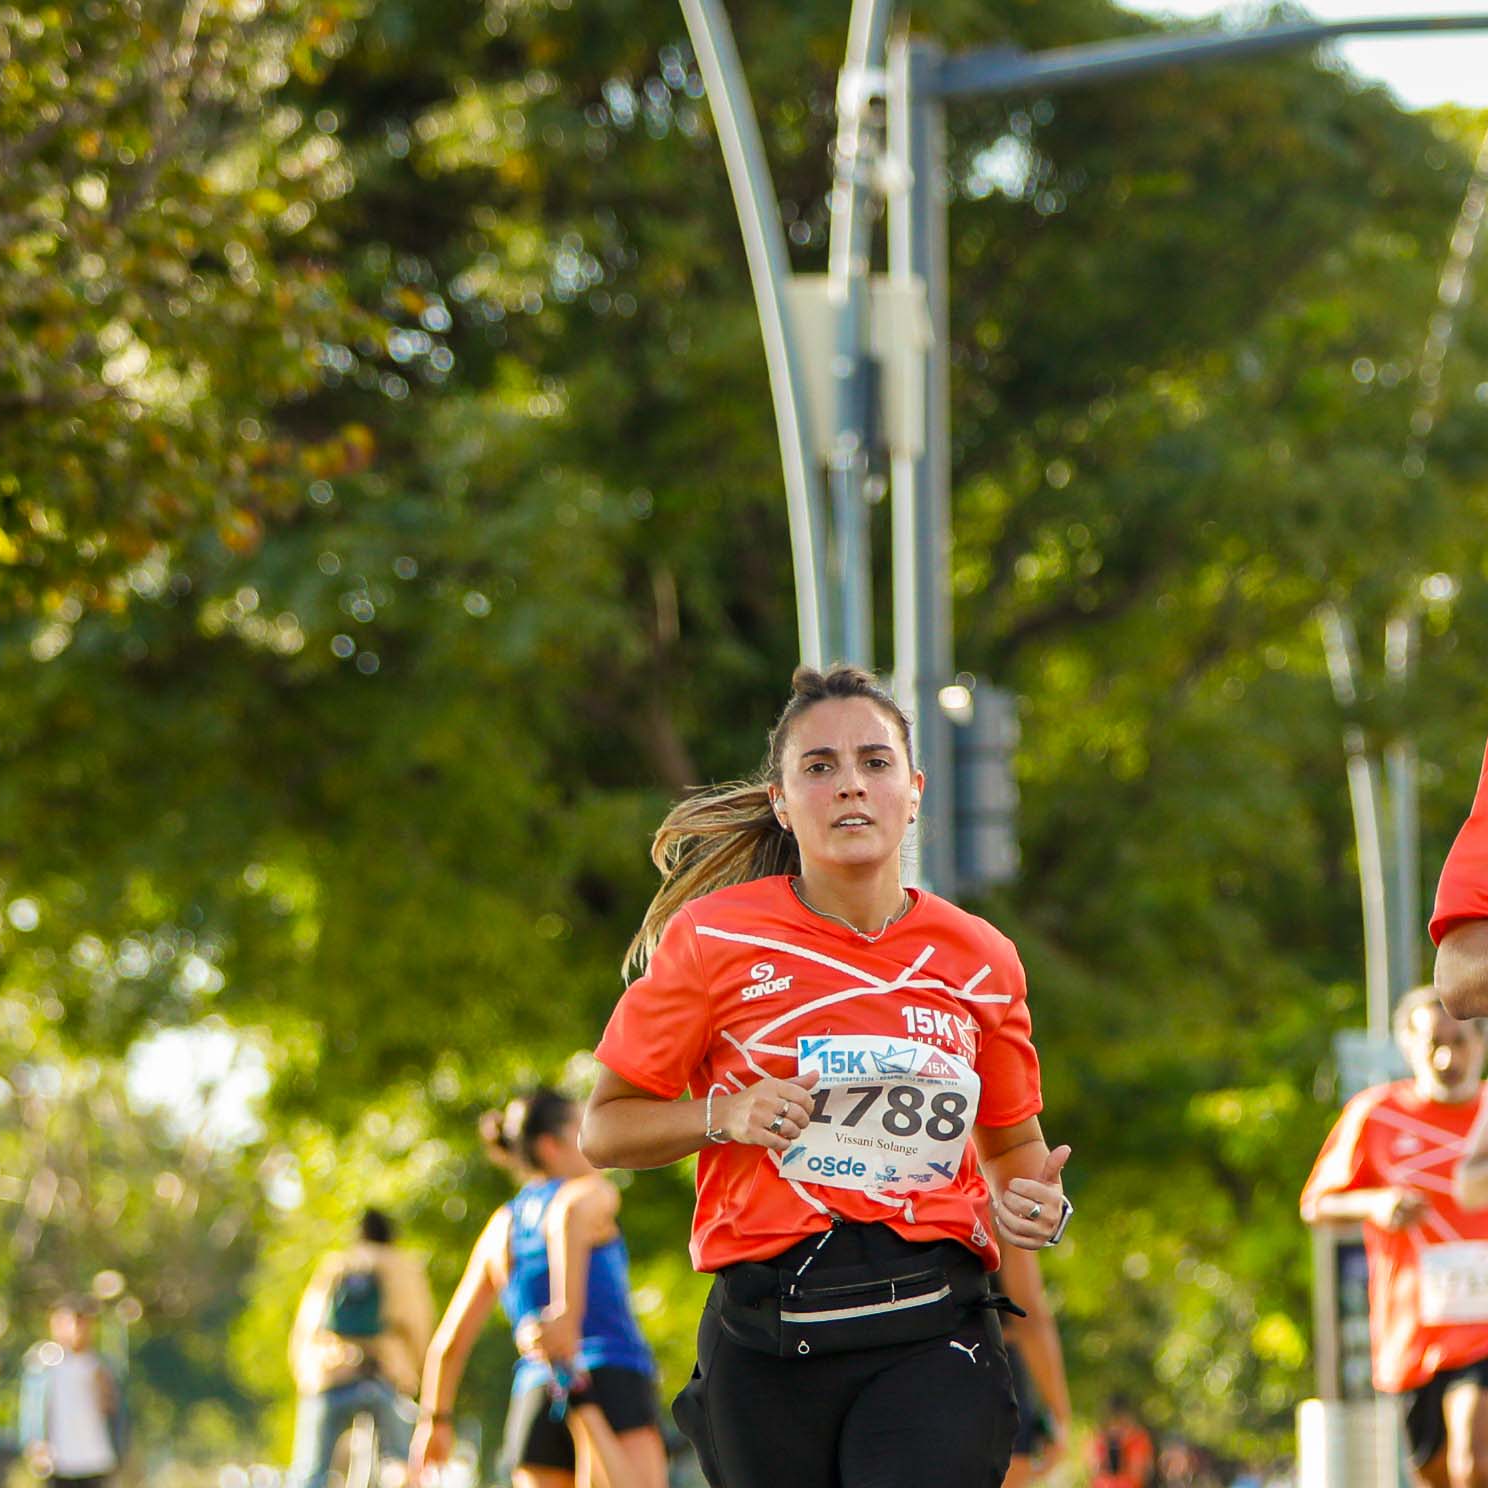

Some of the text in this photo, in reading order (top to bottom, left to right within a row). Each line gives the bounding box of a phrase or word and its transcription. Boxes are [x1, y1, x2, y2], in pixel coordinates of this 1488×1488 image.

[902, 1006, 954, 1041] 15K
[818, 1051, 867, 1075] 15K
[926, 1062, 950, 1075] 15K
[810, 1085, 968, 1142] 1788
[834, 1132, 918, 1156] Vissani Solange
[807, 1156, 867, 1177] osde
